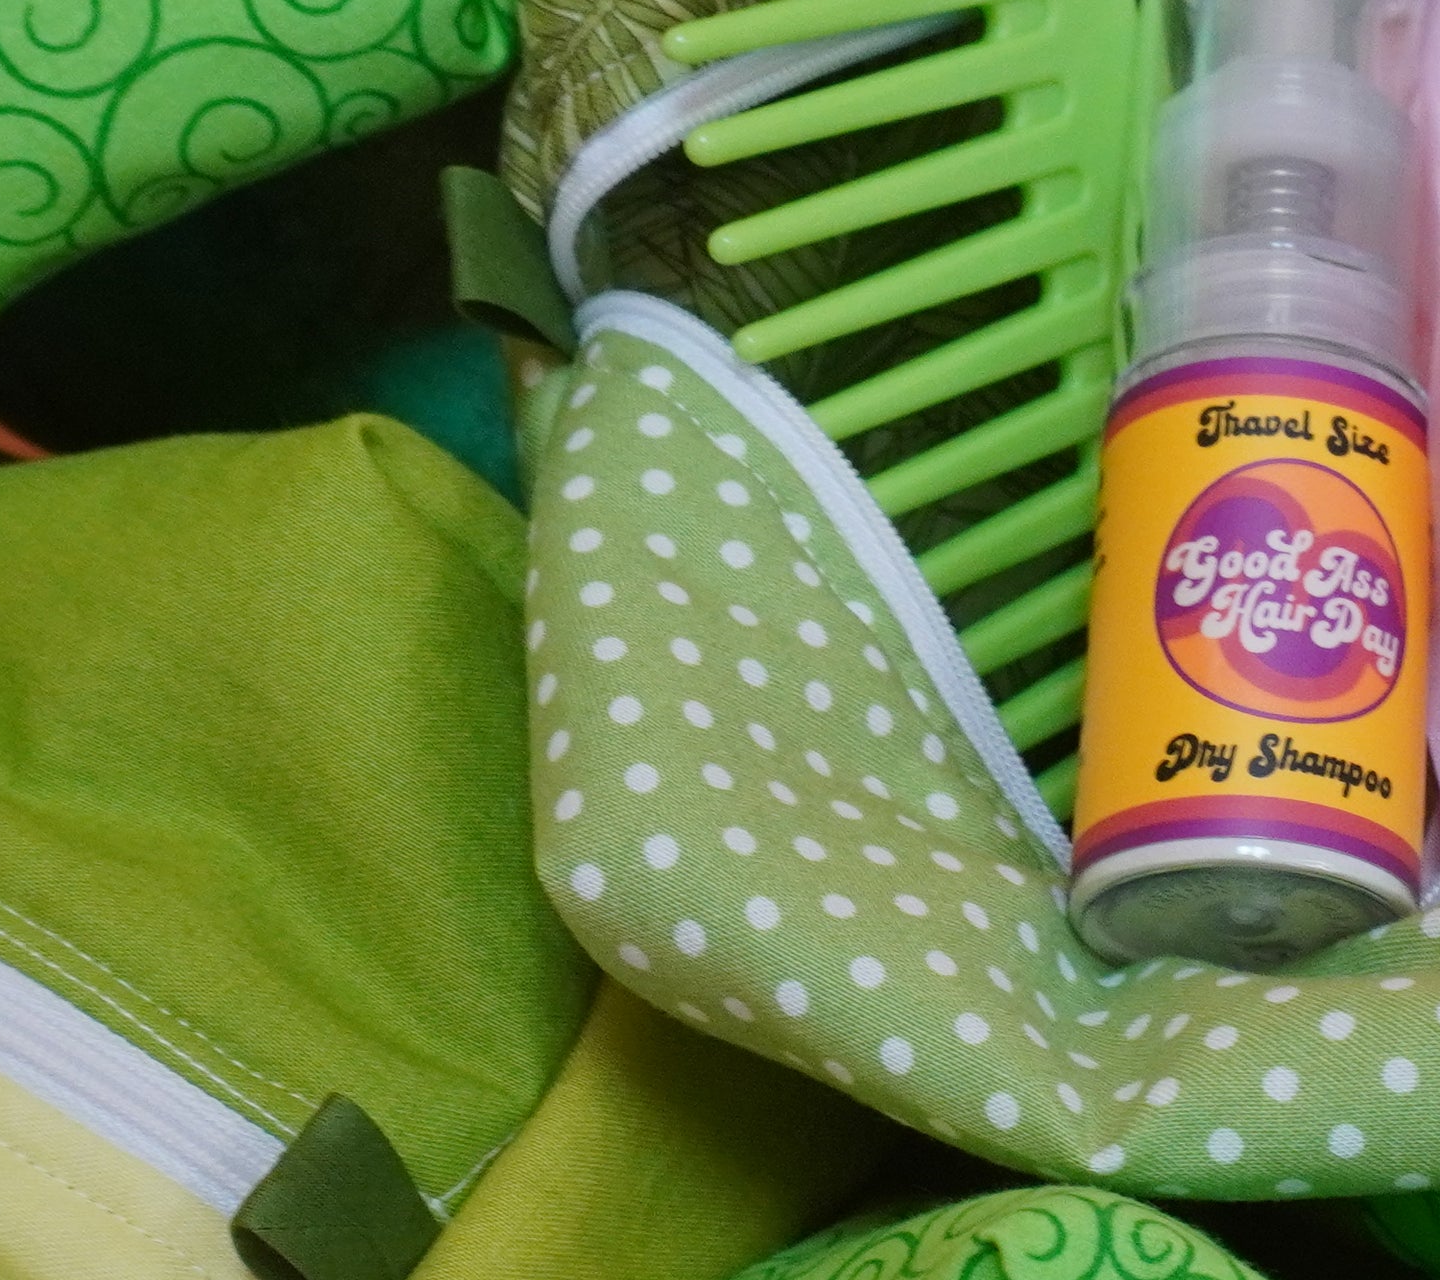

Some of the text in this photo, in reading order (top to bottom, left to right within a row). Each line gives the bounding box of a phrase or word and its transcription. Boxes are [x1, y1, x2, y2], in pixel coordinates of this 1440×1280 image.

[1197, 401, 1390, 465] Travel Size
[1166, 529, 1389, 607] Good Ass
[1201, 581, 1399, 677] Hair Day
[1155, 733, 1392, 799] Dry Shampoo
